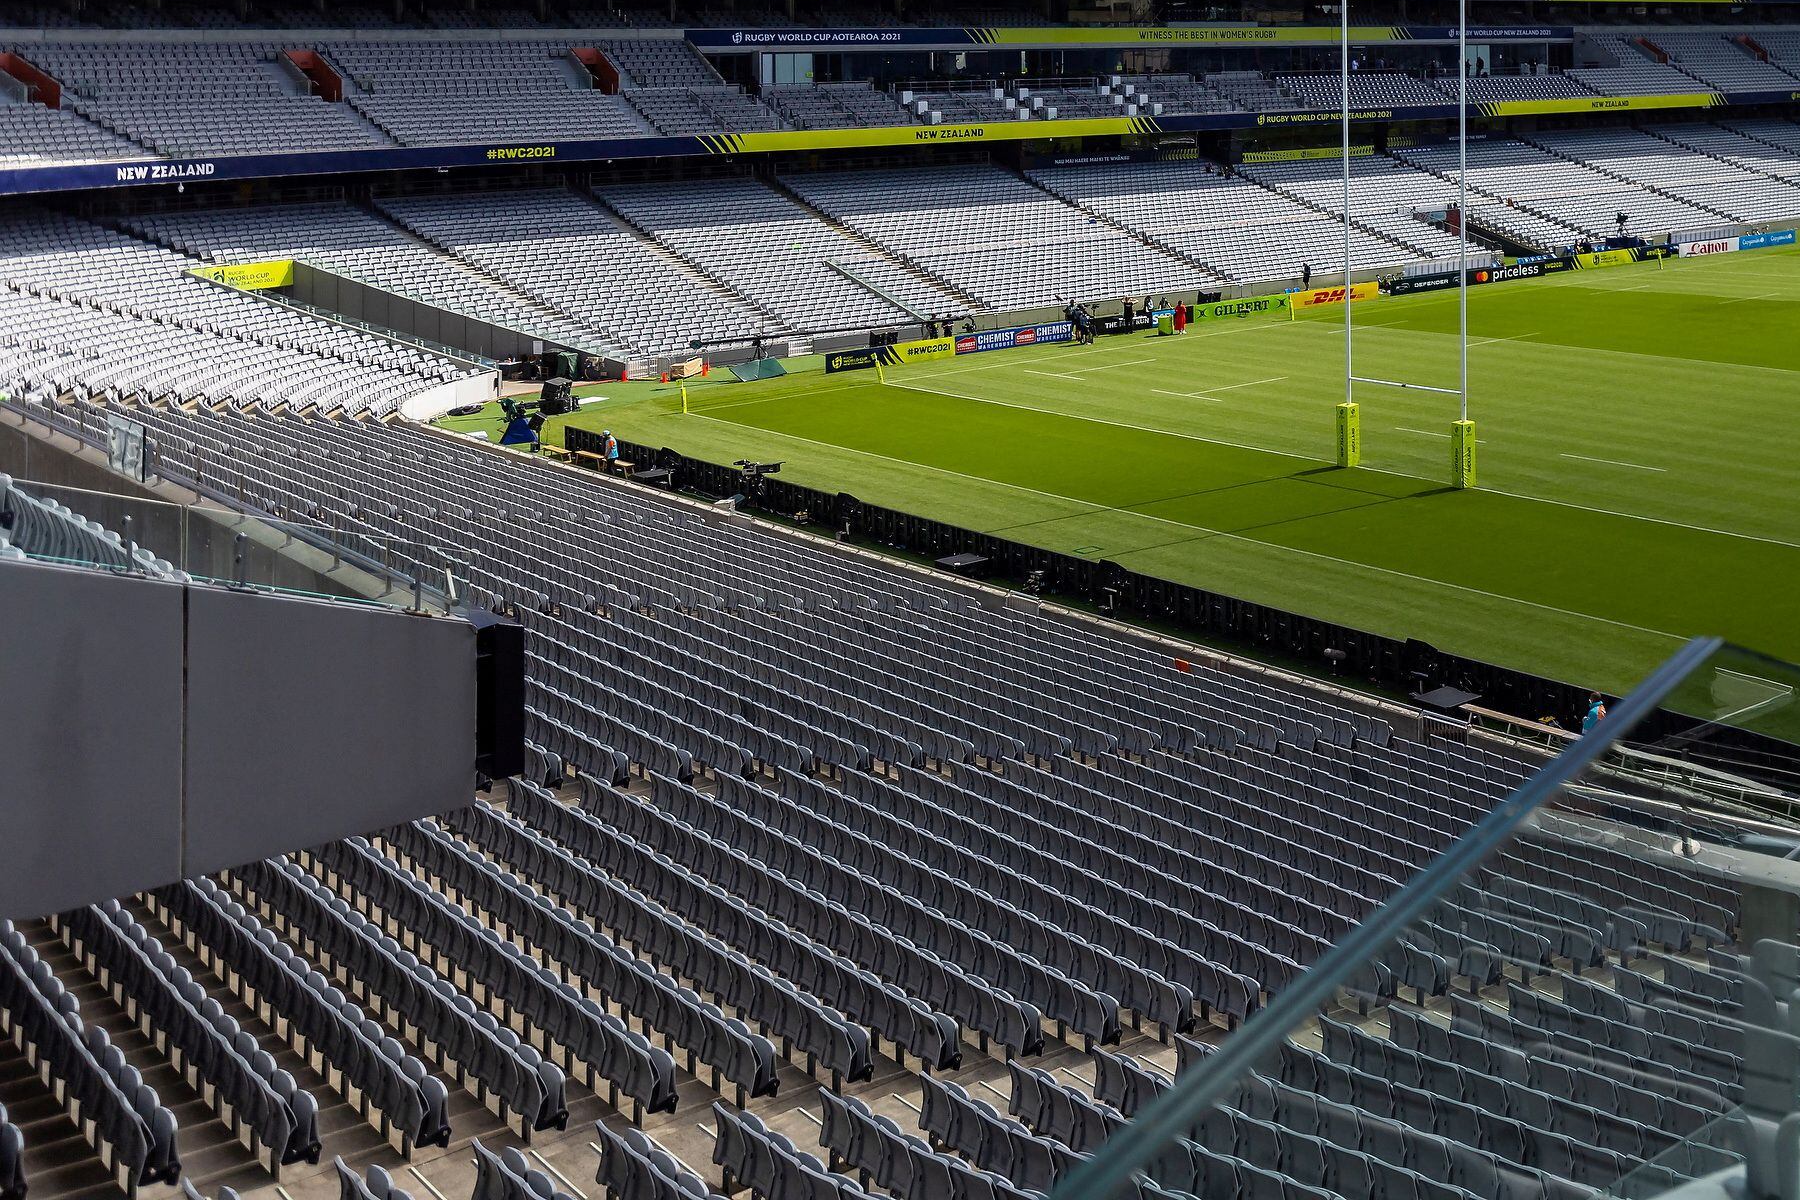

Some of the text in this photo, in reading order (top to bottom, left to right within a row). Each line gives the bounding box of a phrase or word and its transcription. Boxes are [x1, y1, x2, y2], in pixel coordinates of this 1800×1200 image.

[744, 34, 775, 42] RUGBY
[832, 33, 879, 41] AOTEAROA
[1138, 30, 1277, 40] WITNESS THE BEST IN WOMEN'S RUGBY
[1290, 114, 1316, 122] WORLD
[916, 128, 984, 139] NEW ZEALAND
[486, 147, 555, 159] #RWC2021
[117, 163, 215, 181] NEW ZEALAND
[1691, 241, 1728, 254] Canon
[228, 274, 255, 282] WORLD
[1493, 264, 1539, 282] priceless
[1414, 278, 1448, 288] DEFENDER
[1214, 300, 1270, 316] GILBERT
[1036, 324, 1072, 336] CHEMIST
[1105, 321, 1118, 329] THE
[978, 332, 1014, 344] CHEMIST
[1036, 333, 1071, 342] WAREHOUSE
[907, 343, 950, 356] #RWC2021
[978, 341, 1013, 350] WAREHOUSE
